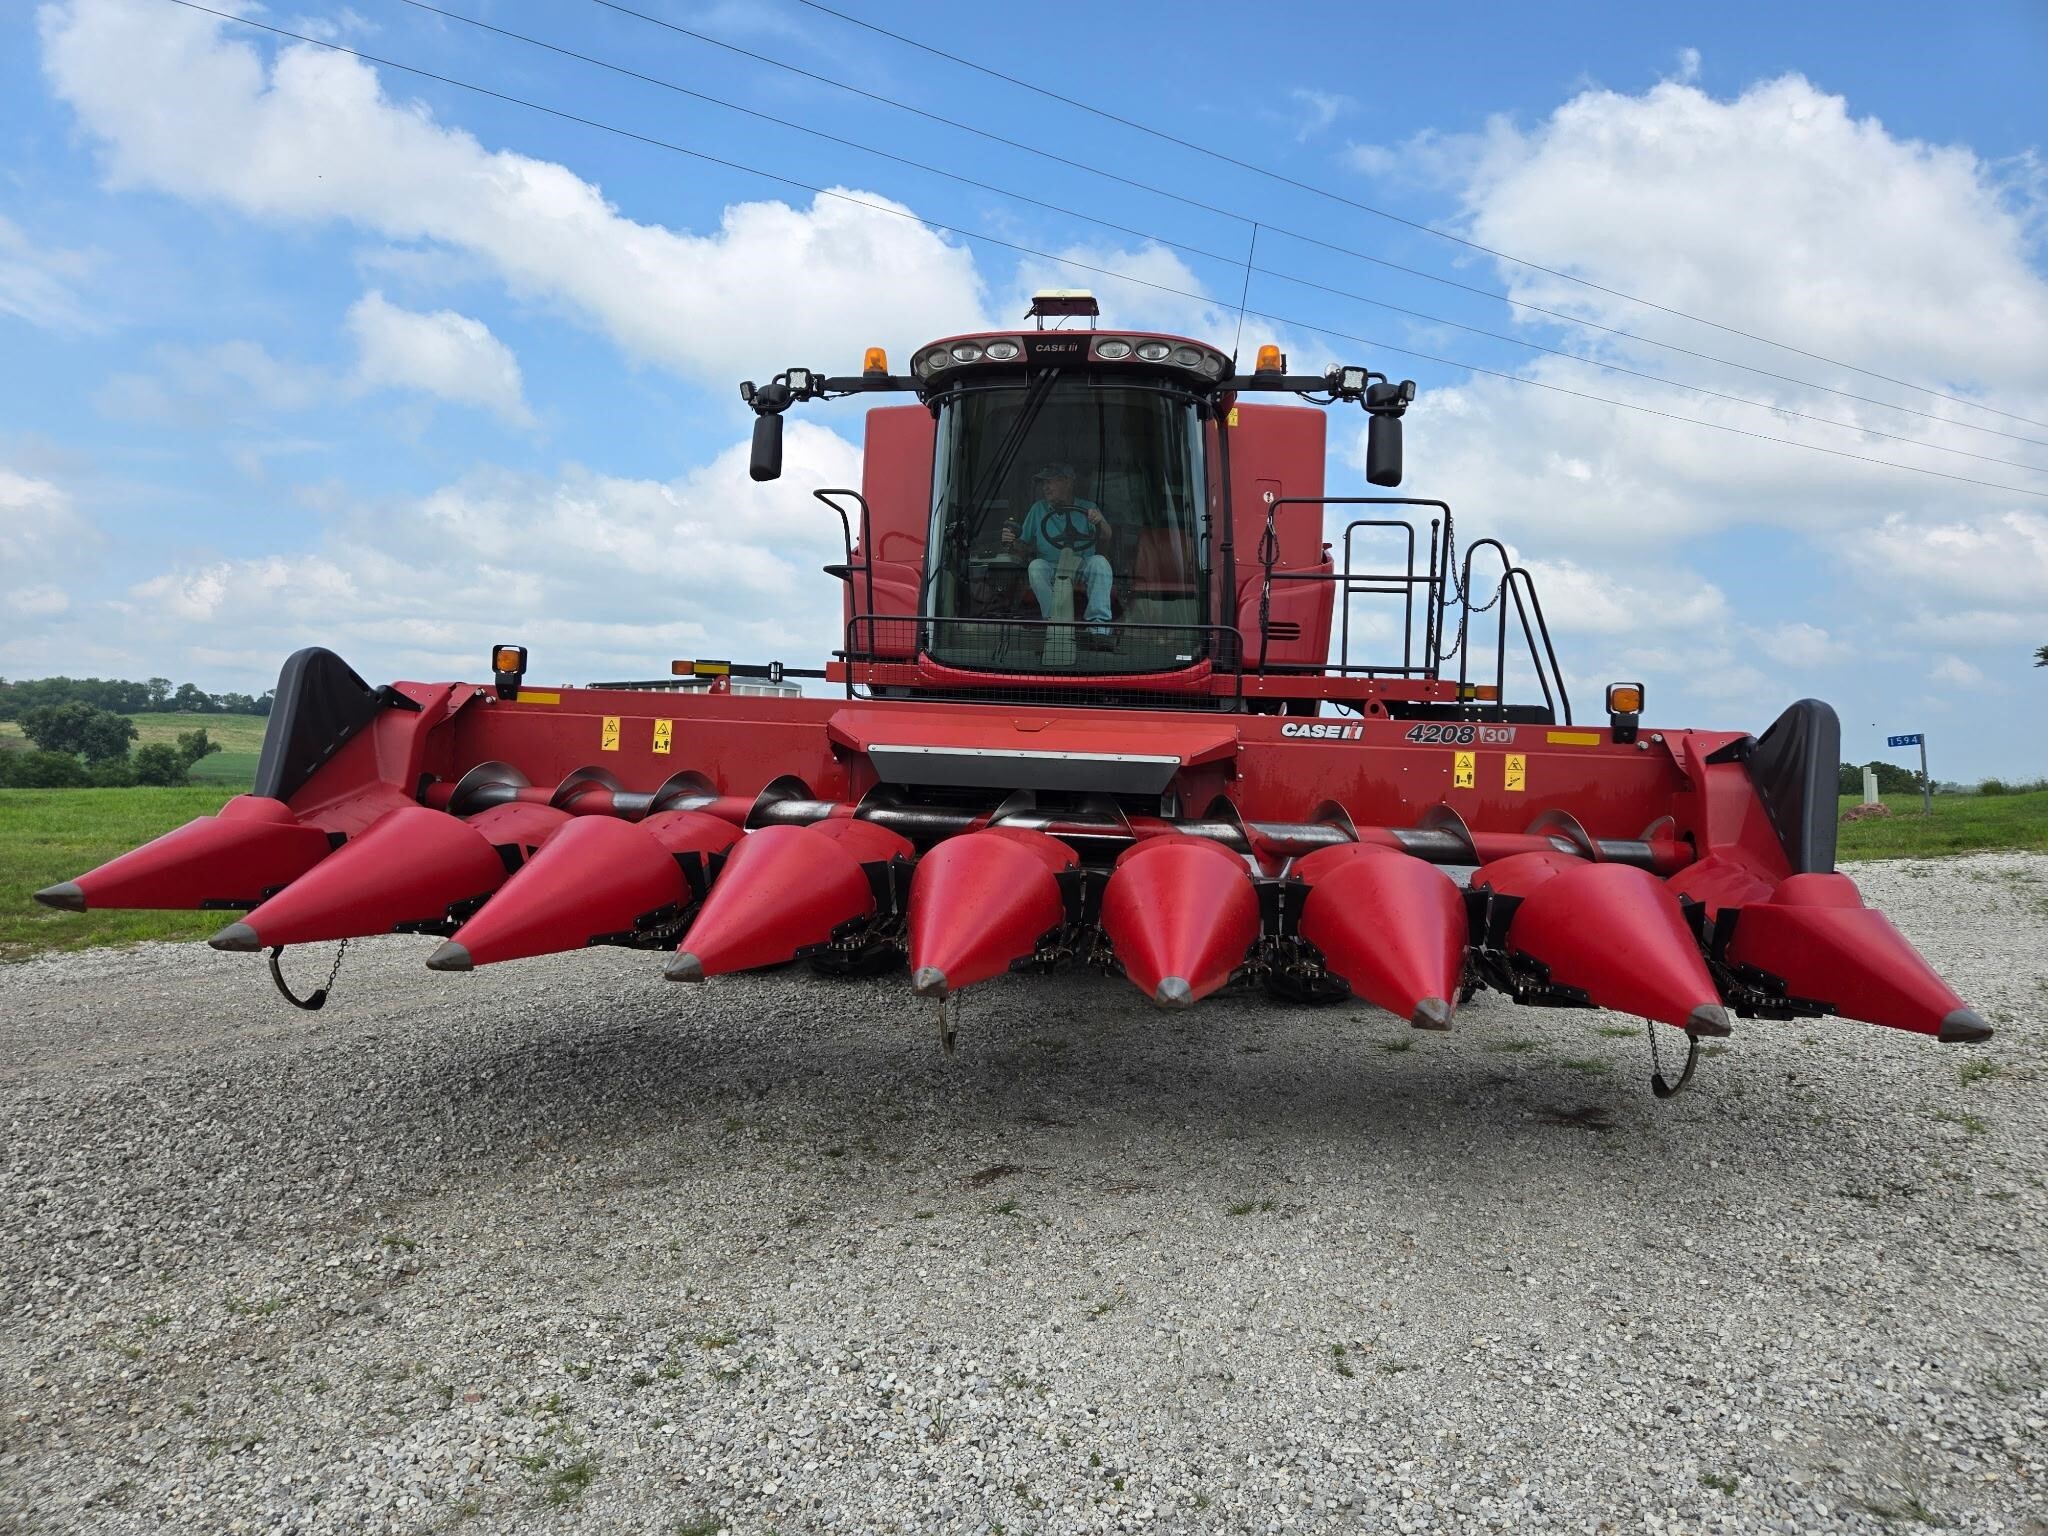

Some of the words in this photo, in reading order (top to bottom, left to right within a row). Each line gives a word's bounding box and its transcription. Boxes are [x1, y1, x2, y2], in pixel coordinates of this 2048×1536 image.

[1035, 344, 1066, 352] CASE
[1281, 722, 1342, 739] CASE
[1404, 723, 1476, 745] 4208
[1486, 728, 1509, 742] 30
[1890, 736, 1918, 746] 1594
